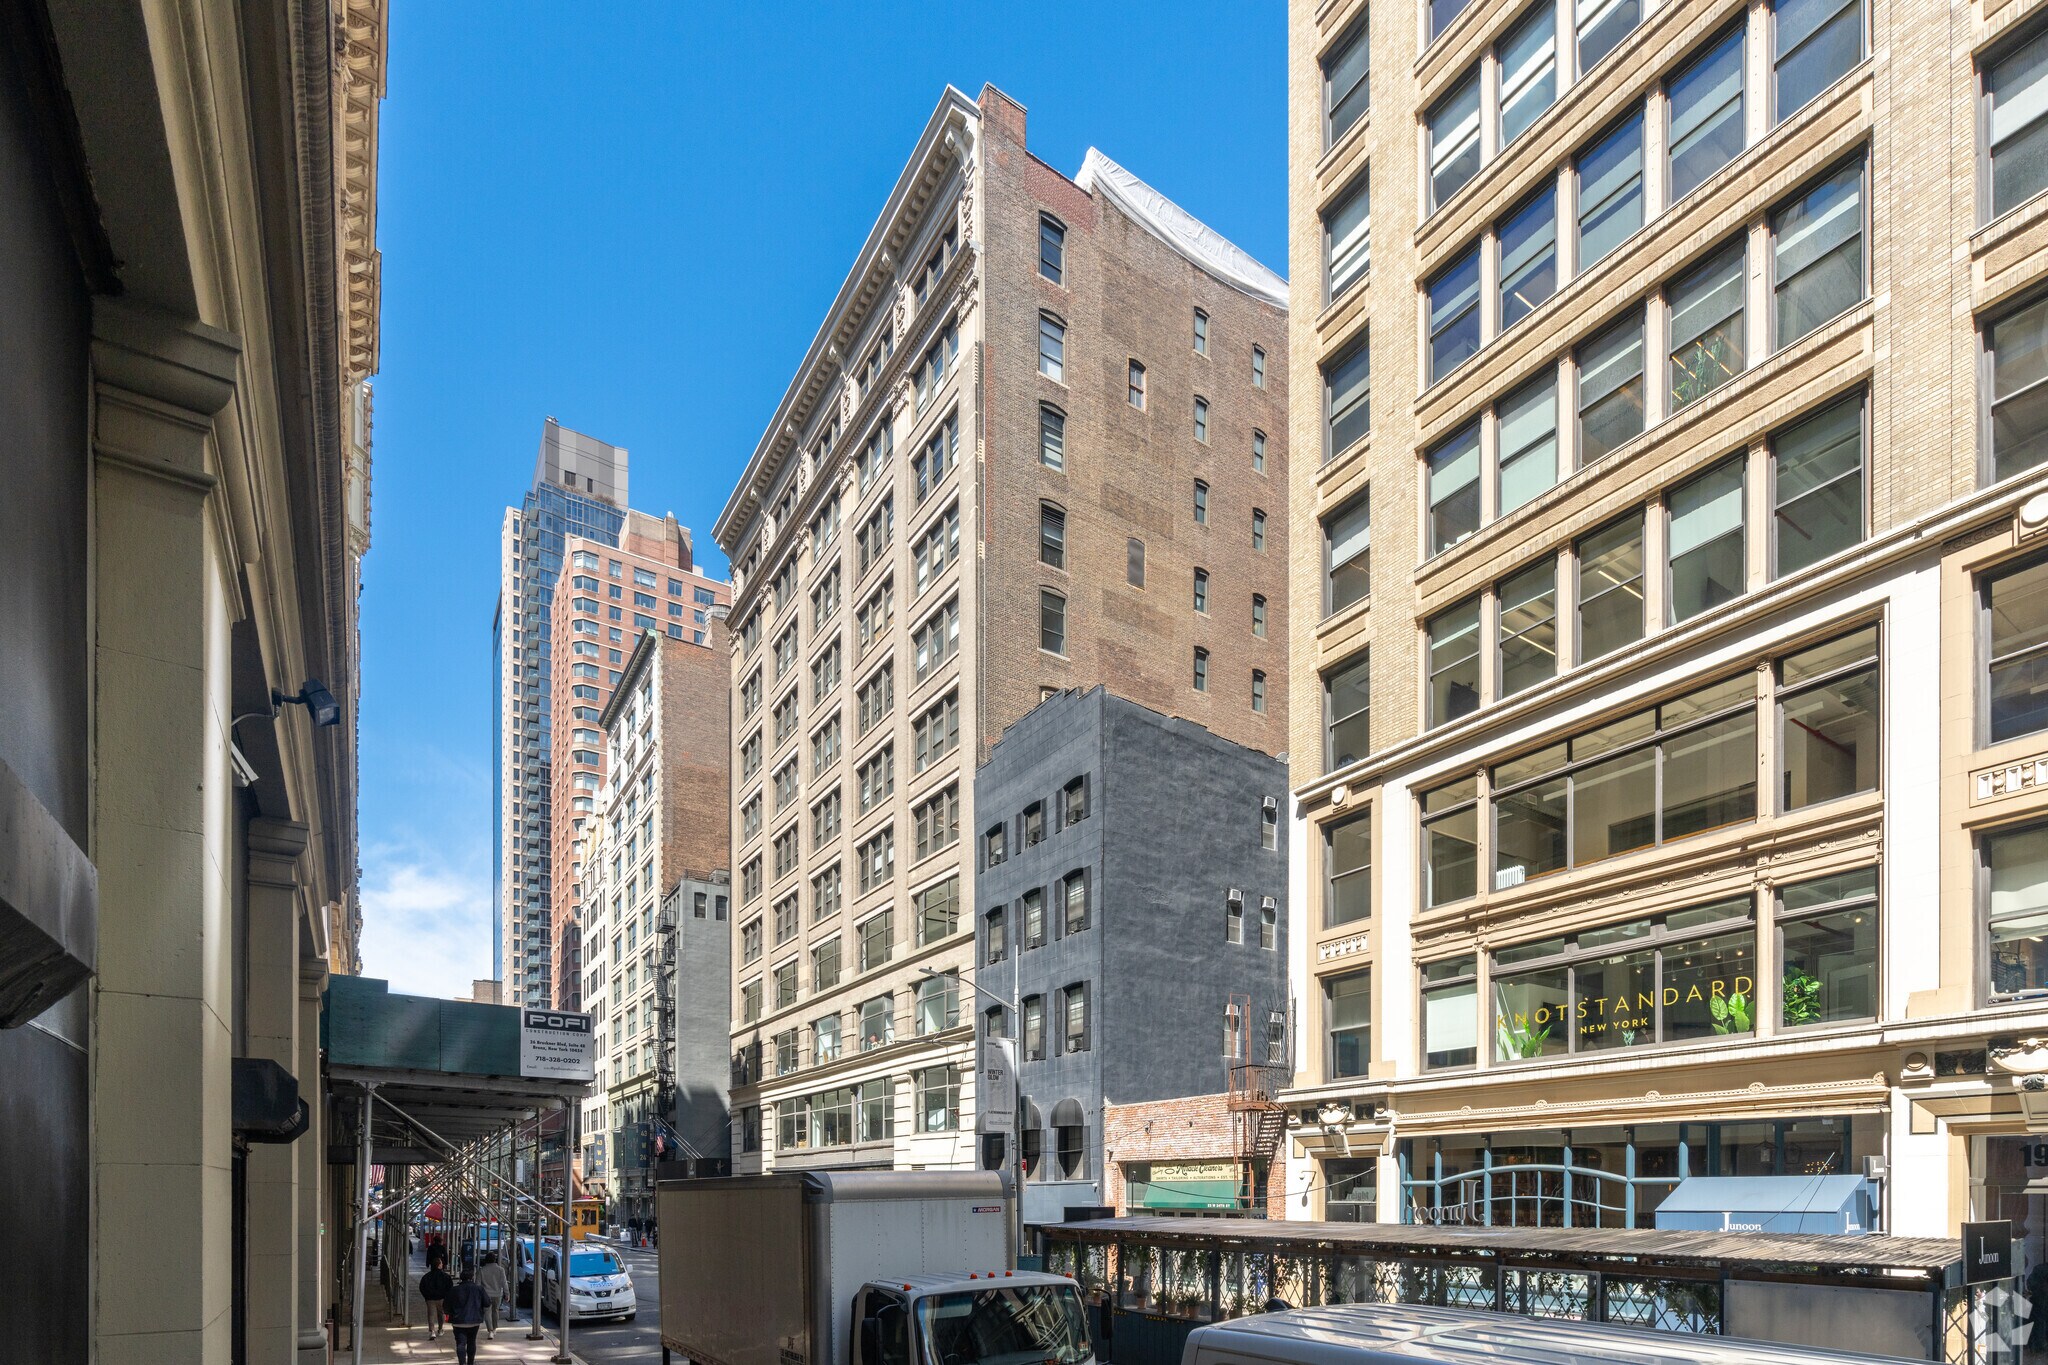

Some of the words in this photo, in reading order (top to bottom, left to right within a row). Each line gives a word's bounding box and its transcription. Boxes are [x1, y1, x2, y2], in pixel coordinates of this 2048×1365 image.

[530, 1014, 586, 1030] POFI
[1580, 1023, 1607, 1034] NEW
[1613, 1017, 1649, 1030] YORK
[536, 1056, 580, 1064] 718-328-0202
[2019, 1144, 2048, 1167] 19
[1719, 1212, 1762, 1232] Junoon
[1979, 1236, 1999, 1264] Junoon
